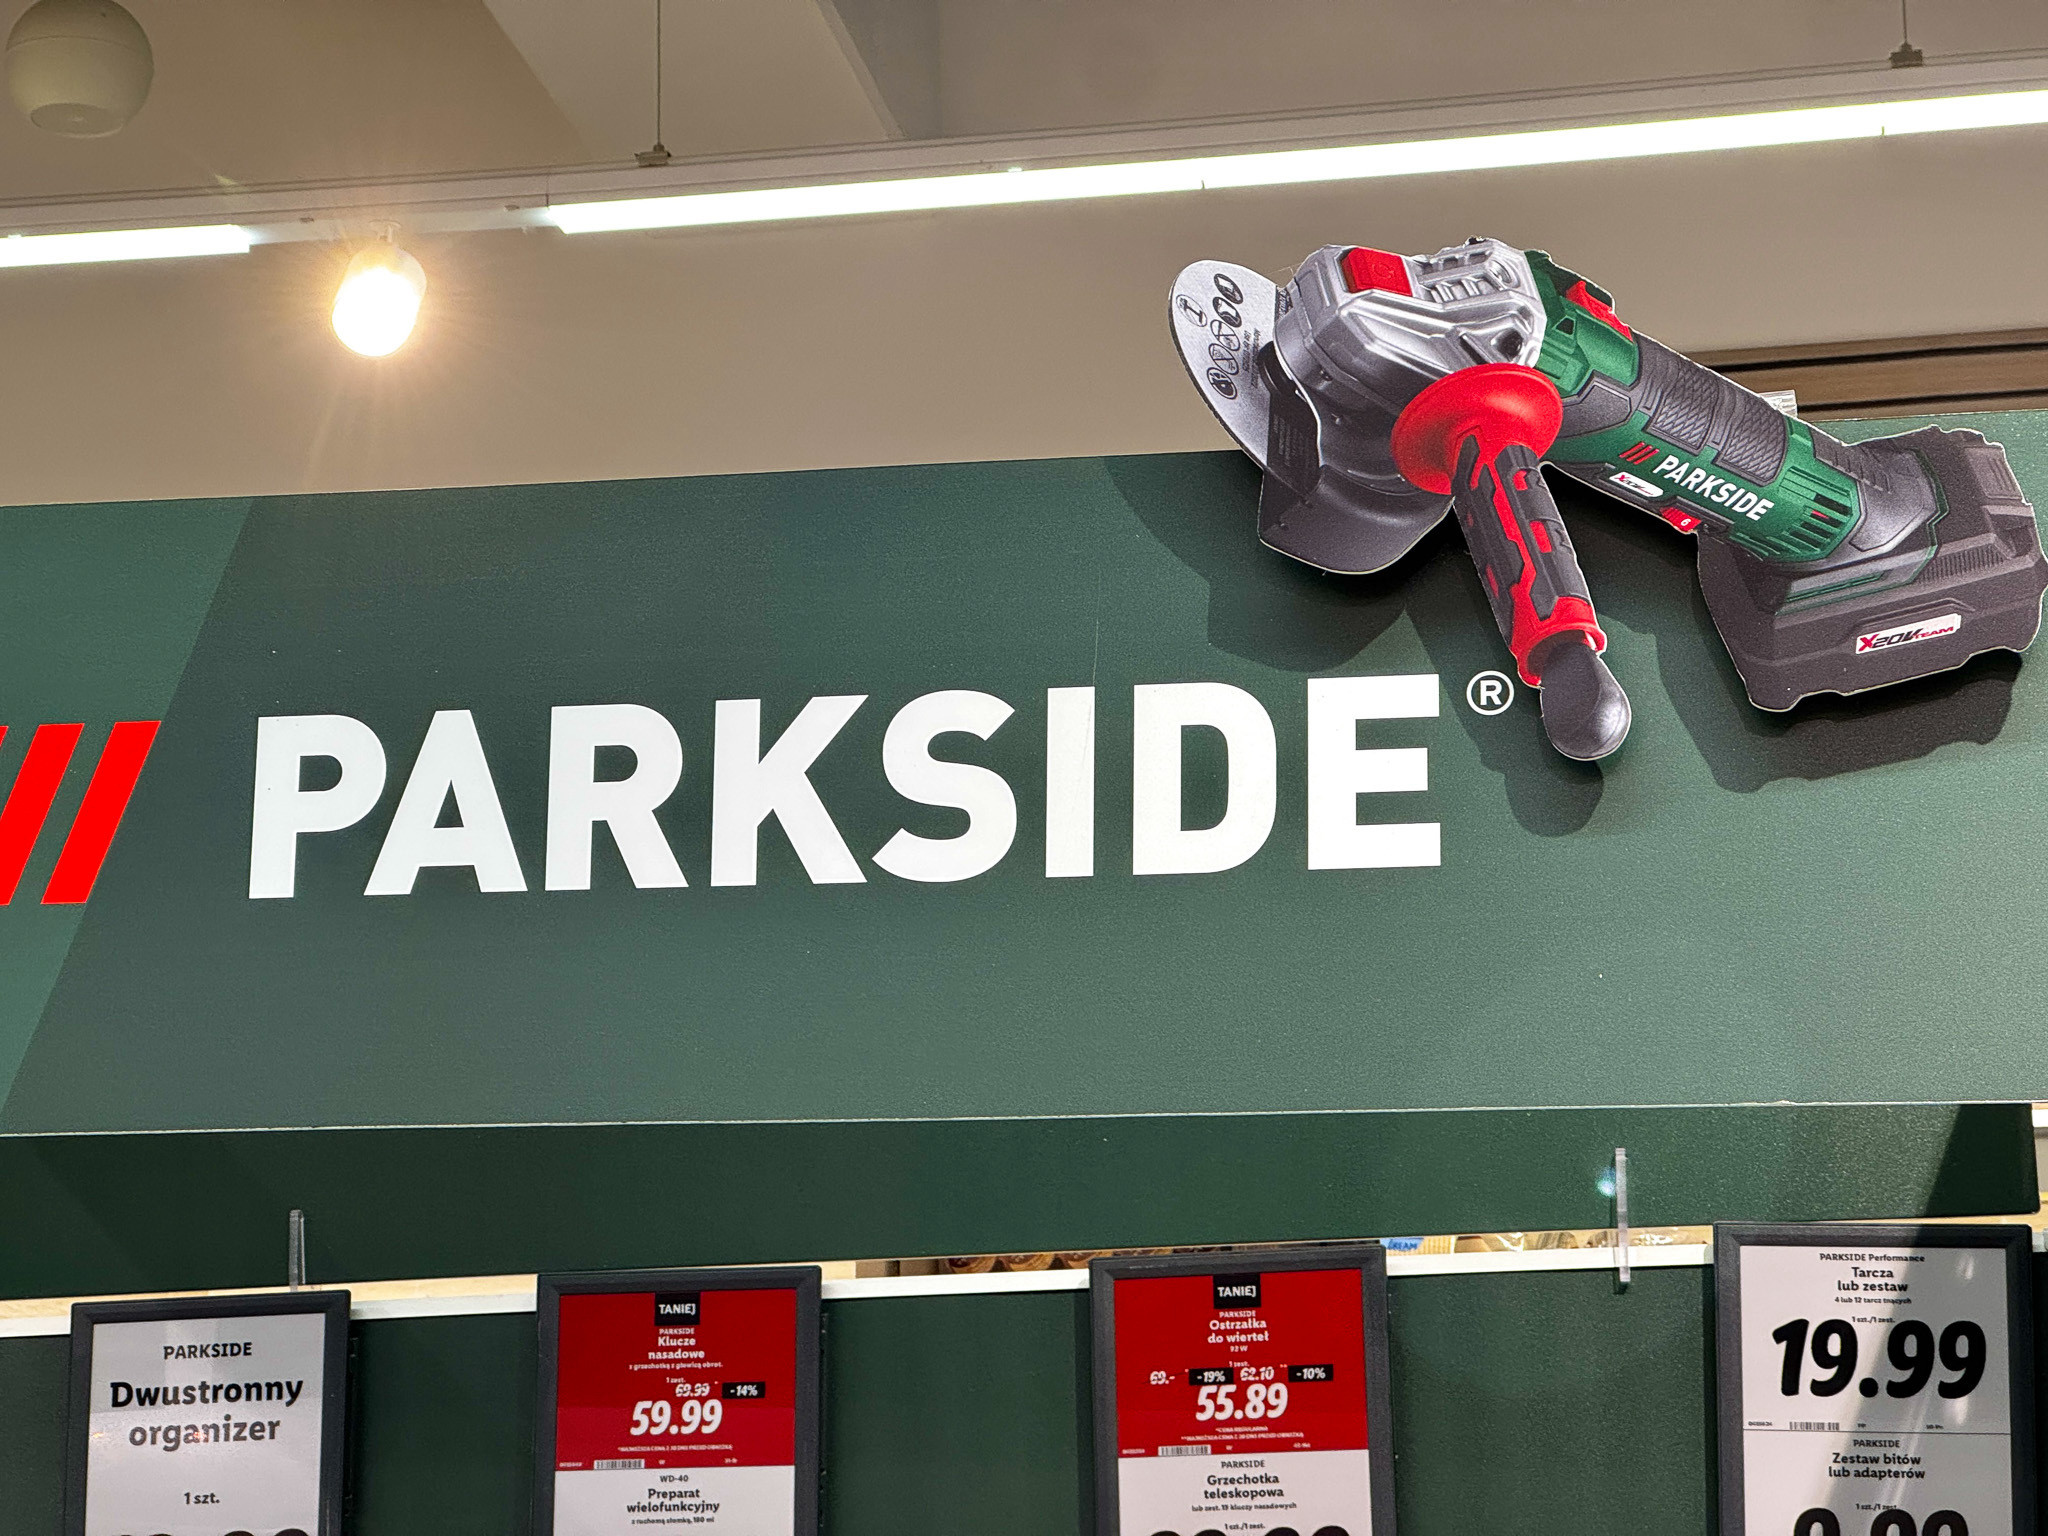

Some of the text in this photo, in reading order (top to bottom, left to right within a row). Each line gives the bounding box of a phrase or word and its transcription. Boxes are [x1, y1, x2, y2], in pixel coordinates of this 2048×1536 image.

[1652, 454, 1775, 521] PARKSIDE
[249, 673, 1442, 900] PARKSIDE
[1819, 1253, 1925, 1262] PARKSIDE Performance
[1851, 1266, 1894, 1278] Tarcza
[1217, 1286, 1257, 1298] TANIEJ
[1837, 1280, 1908, 1292] lub zestaw
[658, 1303, 697, 1316] TANIEJ
[1218, 1310, 1257, 1319] PARKSIDE
[658, 1327, 695, 1335] PARKSIDE
[1208, 1318, 1268, 1331] Ostrzałka
[657, 1335, 696, 1347] Klucze
[1207, 1331, 1270, 1344] do wierteł
[163, 1342, 253, 1360] PARKSIDE
[647, 1348, 705, 1360] nasadowe
[1772, 1318, 1987, 1399] 19.99
[109, 1379, 304, 1408] Dwustronny
[1195, 1382, 1289, 1421] 55.89
[629, 1399, 723, 1436] 59.99
[128, 1413, 281, 1452] organizer
[1853, 1439, 1900, 1448] PARKSIDE
[1220, 1460, 1265, 1469] PARKSIDE
[1832, 1452, 1921, 1466] Zestaw bitów
[659, 1474, 689, 1483] WD-40
[1206, 1472, 1280, 1486] Grzechotka
[1828, 1466, 1926, 1481] lub adapterów
[184, 1491, 221, 1505] 1 szt.
[647, 1488, 701, 1501] Preparat
[1203, 1487, 1285, 1500] teleskopowa
[626, 1500, 720, 1514] wielofunkcyjny
